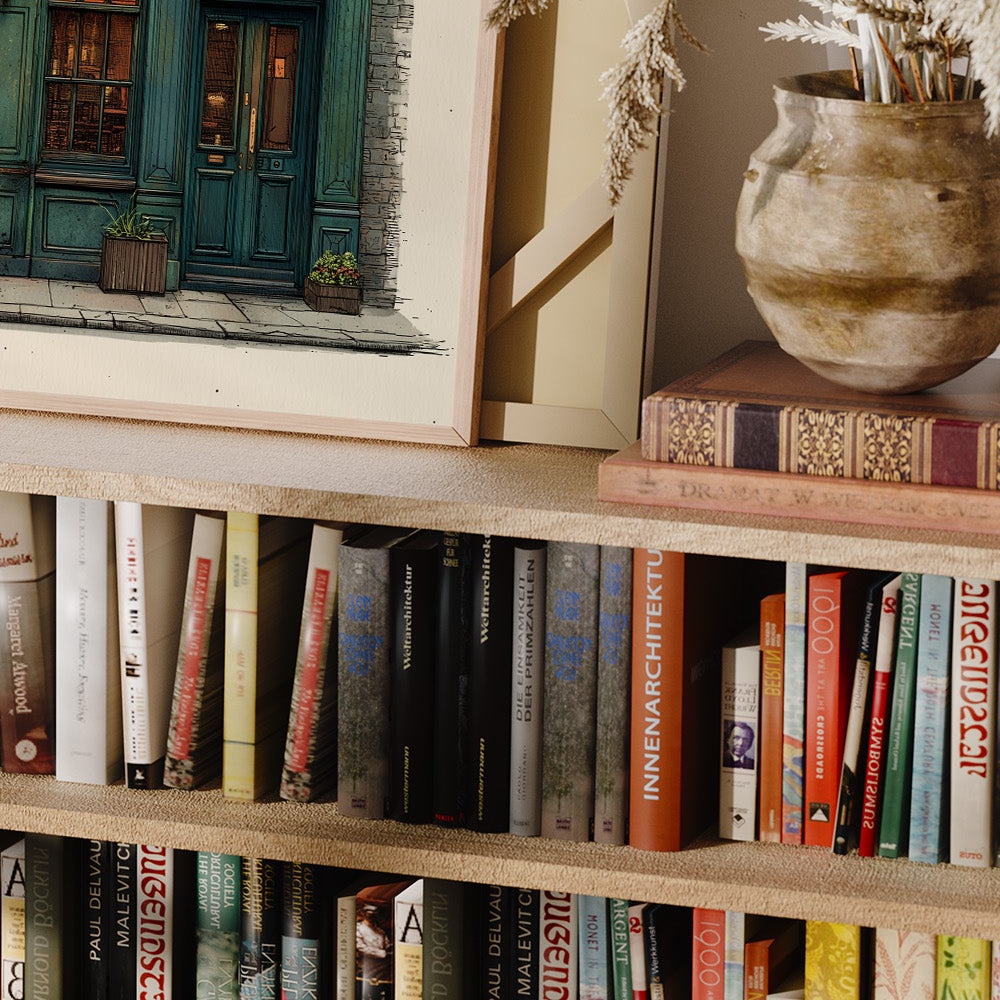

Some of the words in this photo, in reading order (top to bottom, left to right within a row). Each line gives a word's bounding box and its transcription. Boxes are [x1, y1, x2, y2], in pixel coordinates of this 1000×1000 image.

[6, 594, 23, 658] Margaret
[403, 564, 413, 670] Weltarchitektur
[516, 573, 526, 693] EINSAMKEIT
[524, 558, 535, 679] PRIMZAHLEN
[13, 660, 32, 715] Atwood
[524, 685, 534, 722] DER
[643, 550, 663, 801] INNENARCHITEKTU
[516, 696, 525, 722] DIE
[477, 737, 485, 821] westermann
[89, 916, 101, 961] PAUL
[518, 888, 531, 996] MALEVITC
[586, 914, 598, 952] MONET
[647, 925, 660, 975] Werkkunst
[694, 921, 721, 986] 1900
[488, 963, 501, 1000] AUL
